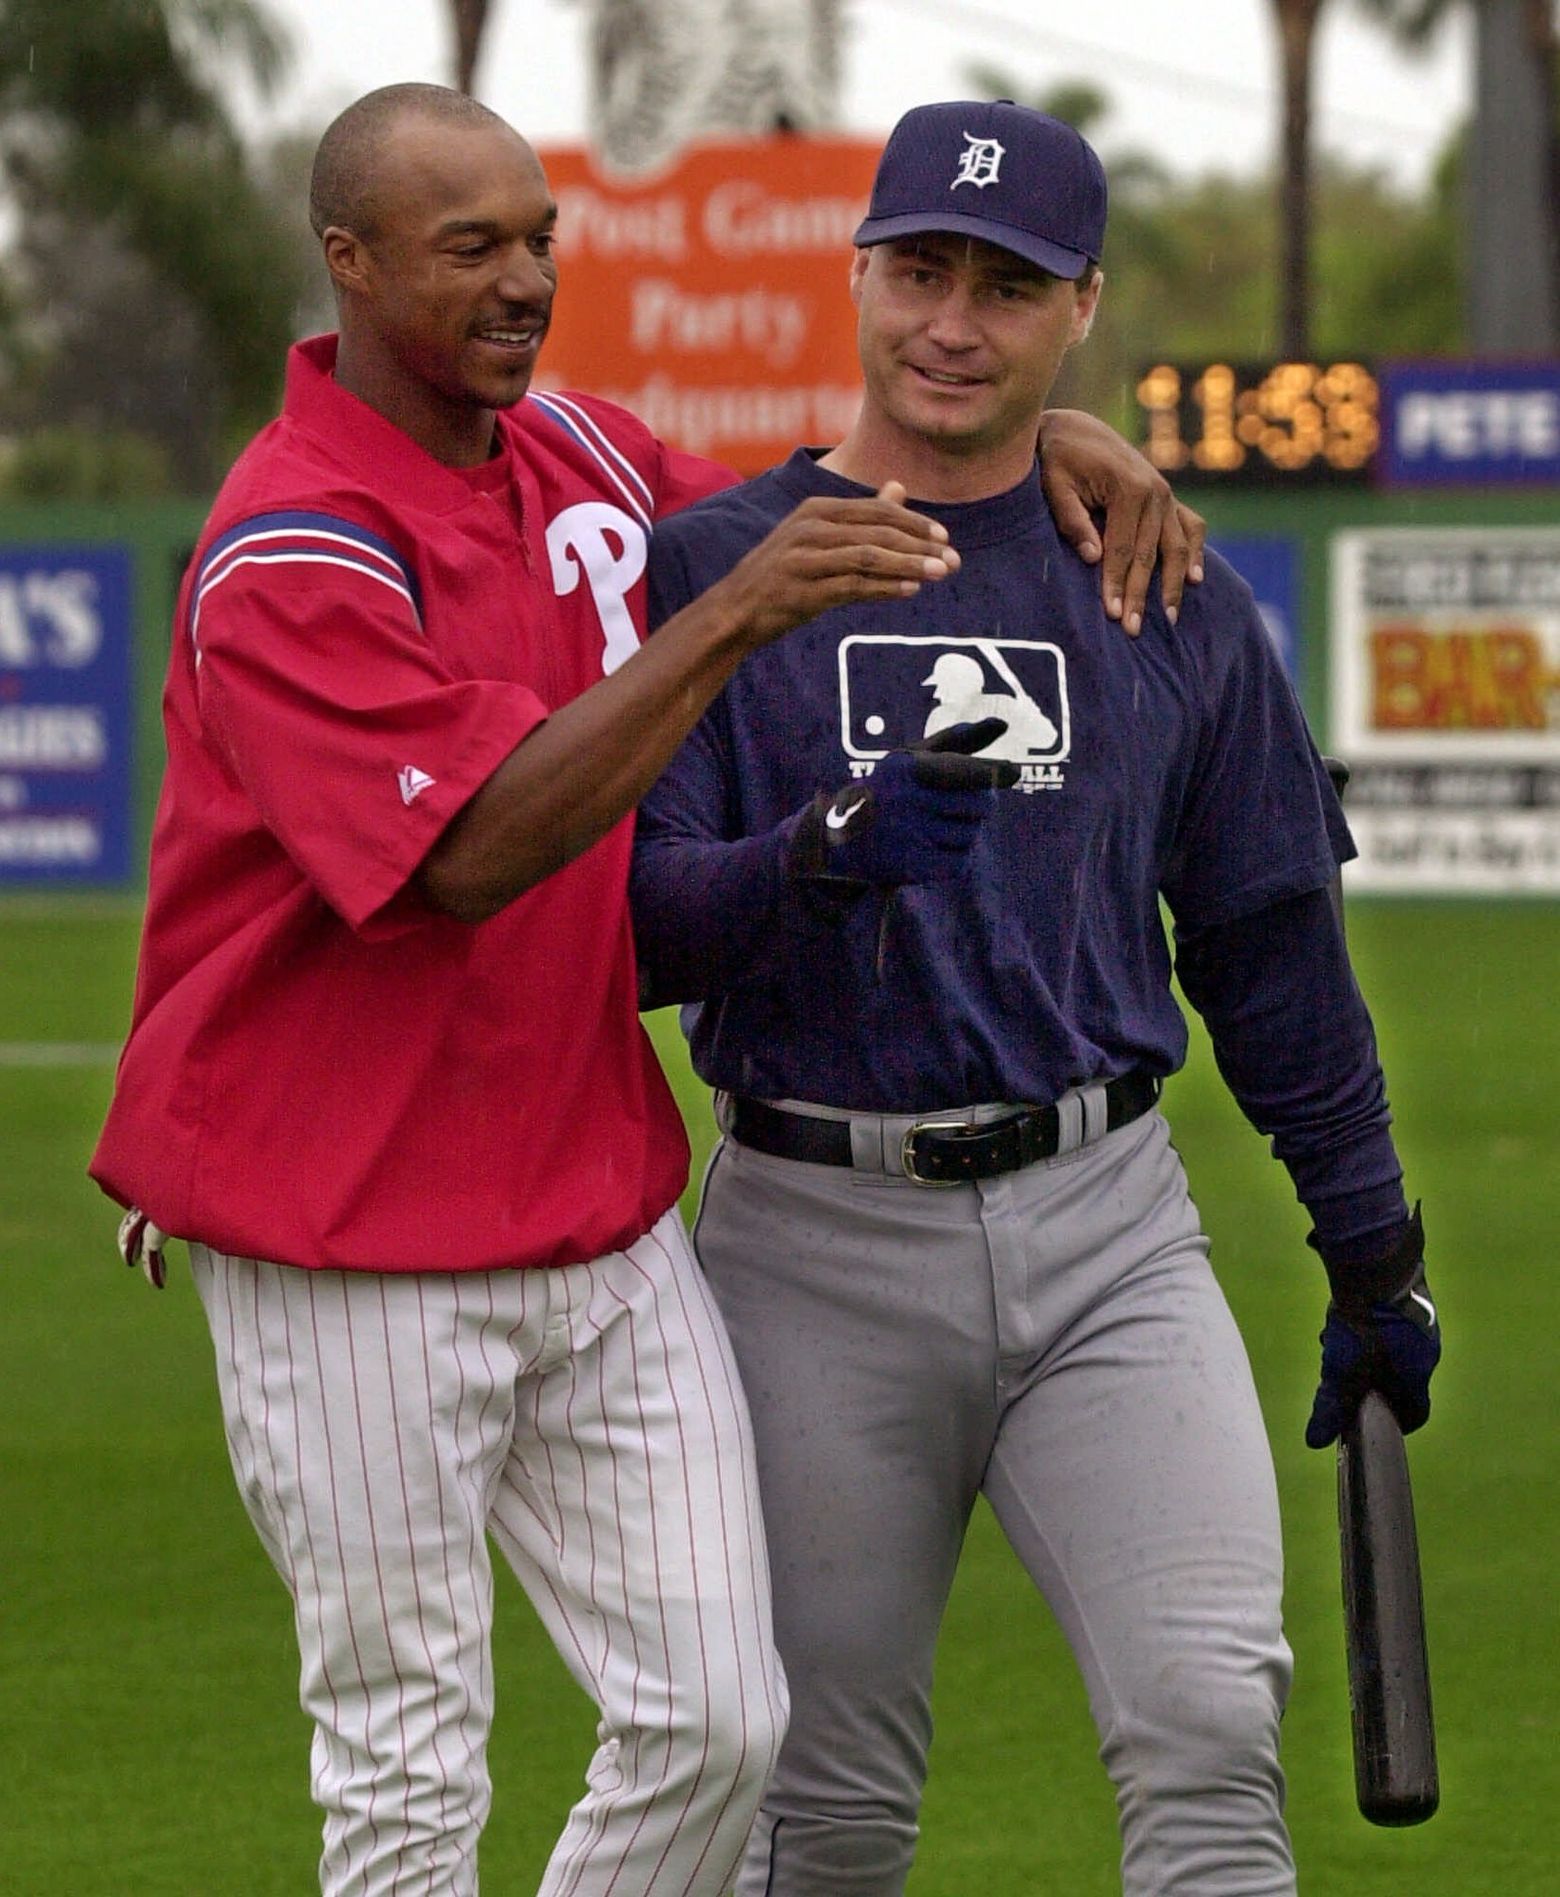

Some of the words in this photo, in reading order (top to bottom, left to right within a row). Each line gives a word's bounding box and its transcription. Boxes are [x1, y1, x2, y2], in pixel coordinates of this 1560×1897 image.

[951, 130, 1006, 190] D
[706, 180, 870, 257] Gam
[631, 278, 806, 369] Party
[545, 501, 648, 676] P
